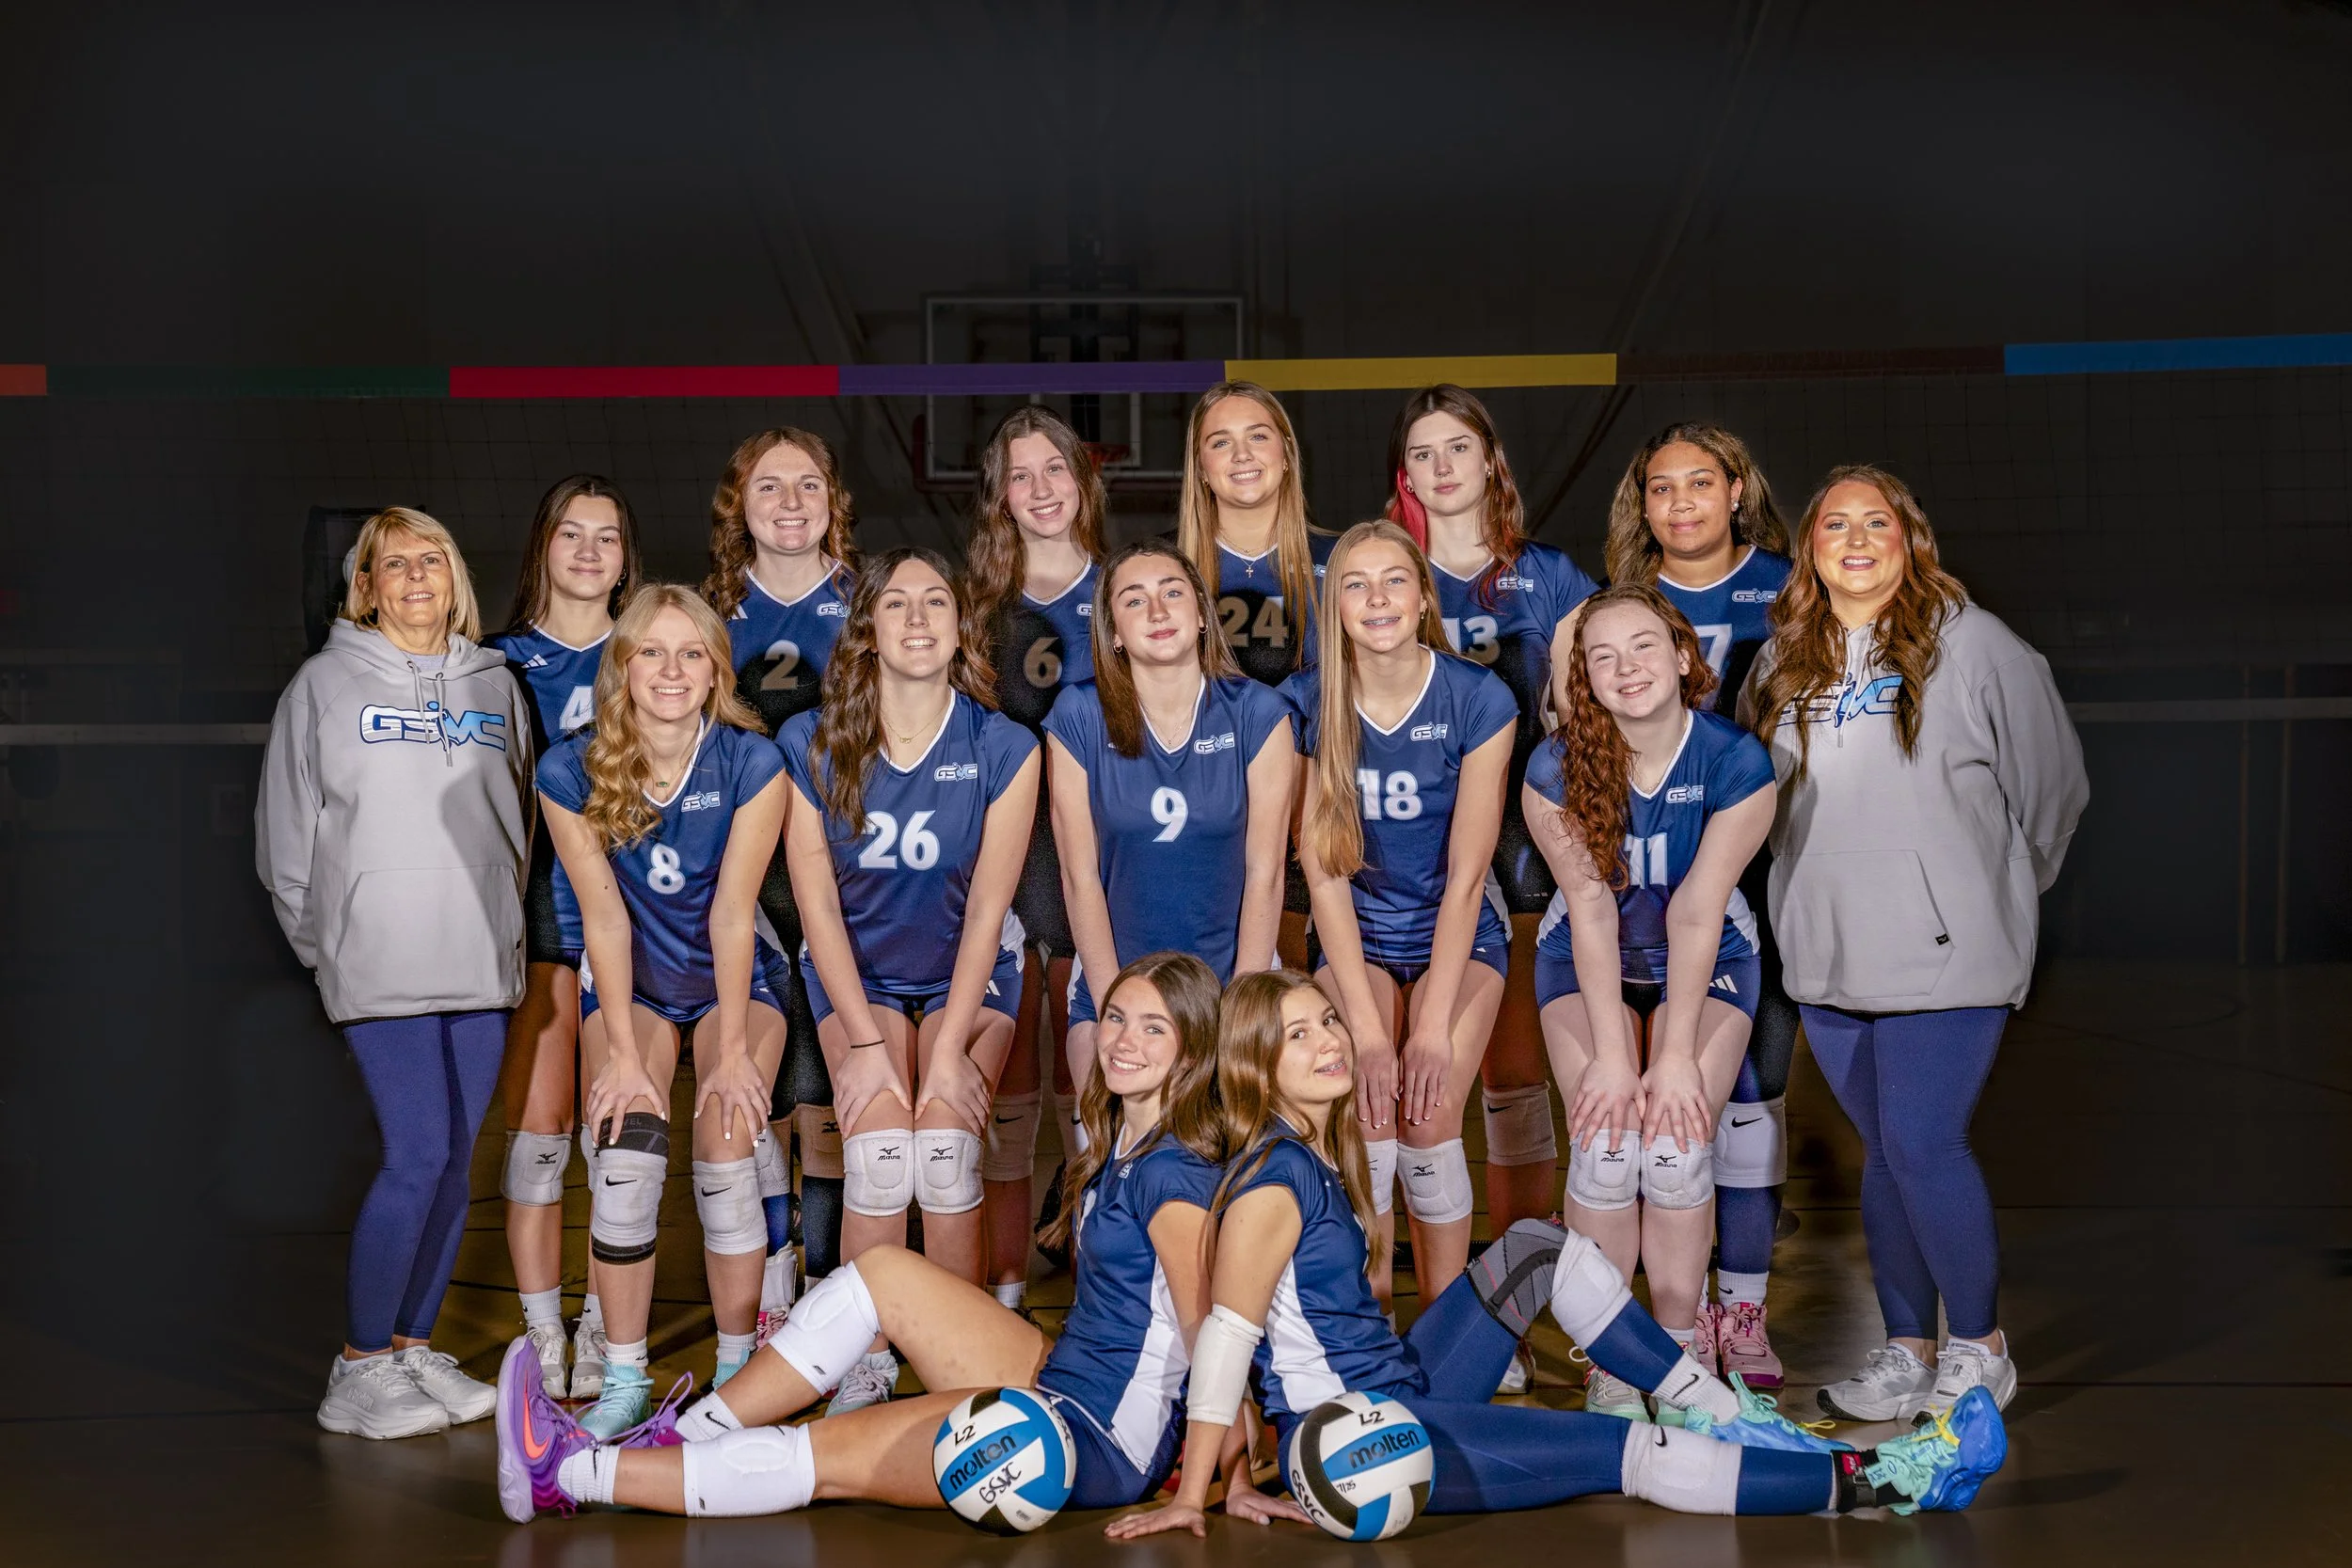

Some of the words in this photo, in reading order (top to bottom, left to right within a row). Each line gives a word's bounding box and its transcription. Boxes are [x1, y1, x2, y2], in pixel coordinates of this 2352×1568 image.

[1217, 595, 1287, 649] 24
[1441, 615, 1502, 665] 13
[760, 640, 800, 690] 2
[1024, 637, 1063, 689] 6
[1694, 624, 1733, 678] 7
[559, 686, 595, 730] 4
[1151, 786, 1189, 842] 9
[1356, 768, 1422, 820] 18
[858, 810, 941, 871] 26
[646, 843, 686, 895] 8
[949, 1434, 1017, 1491] molten
[1348, 1429, 1421, 1470] molten
